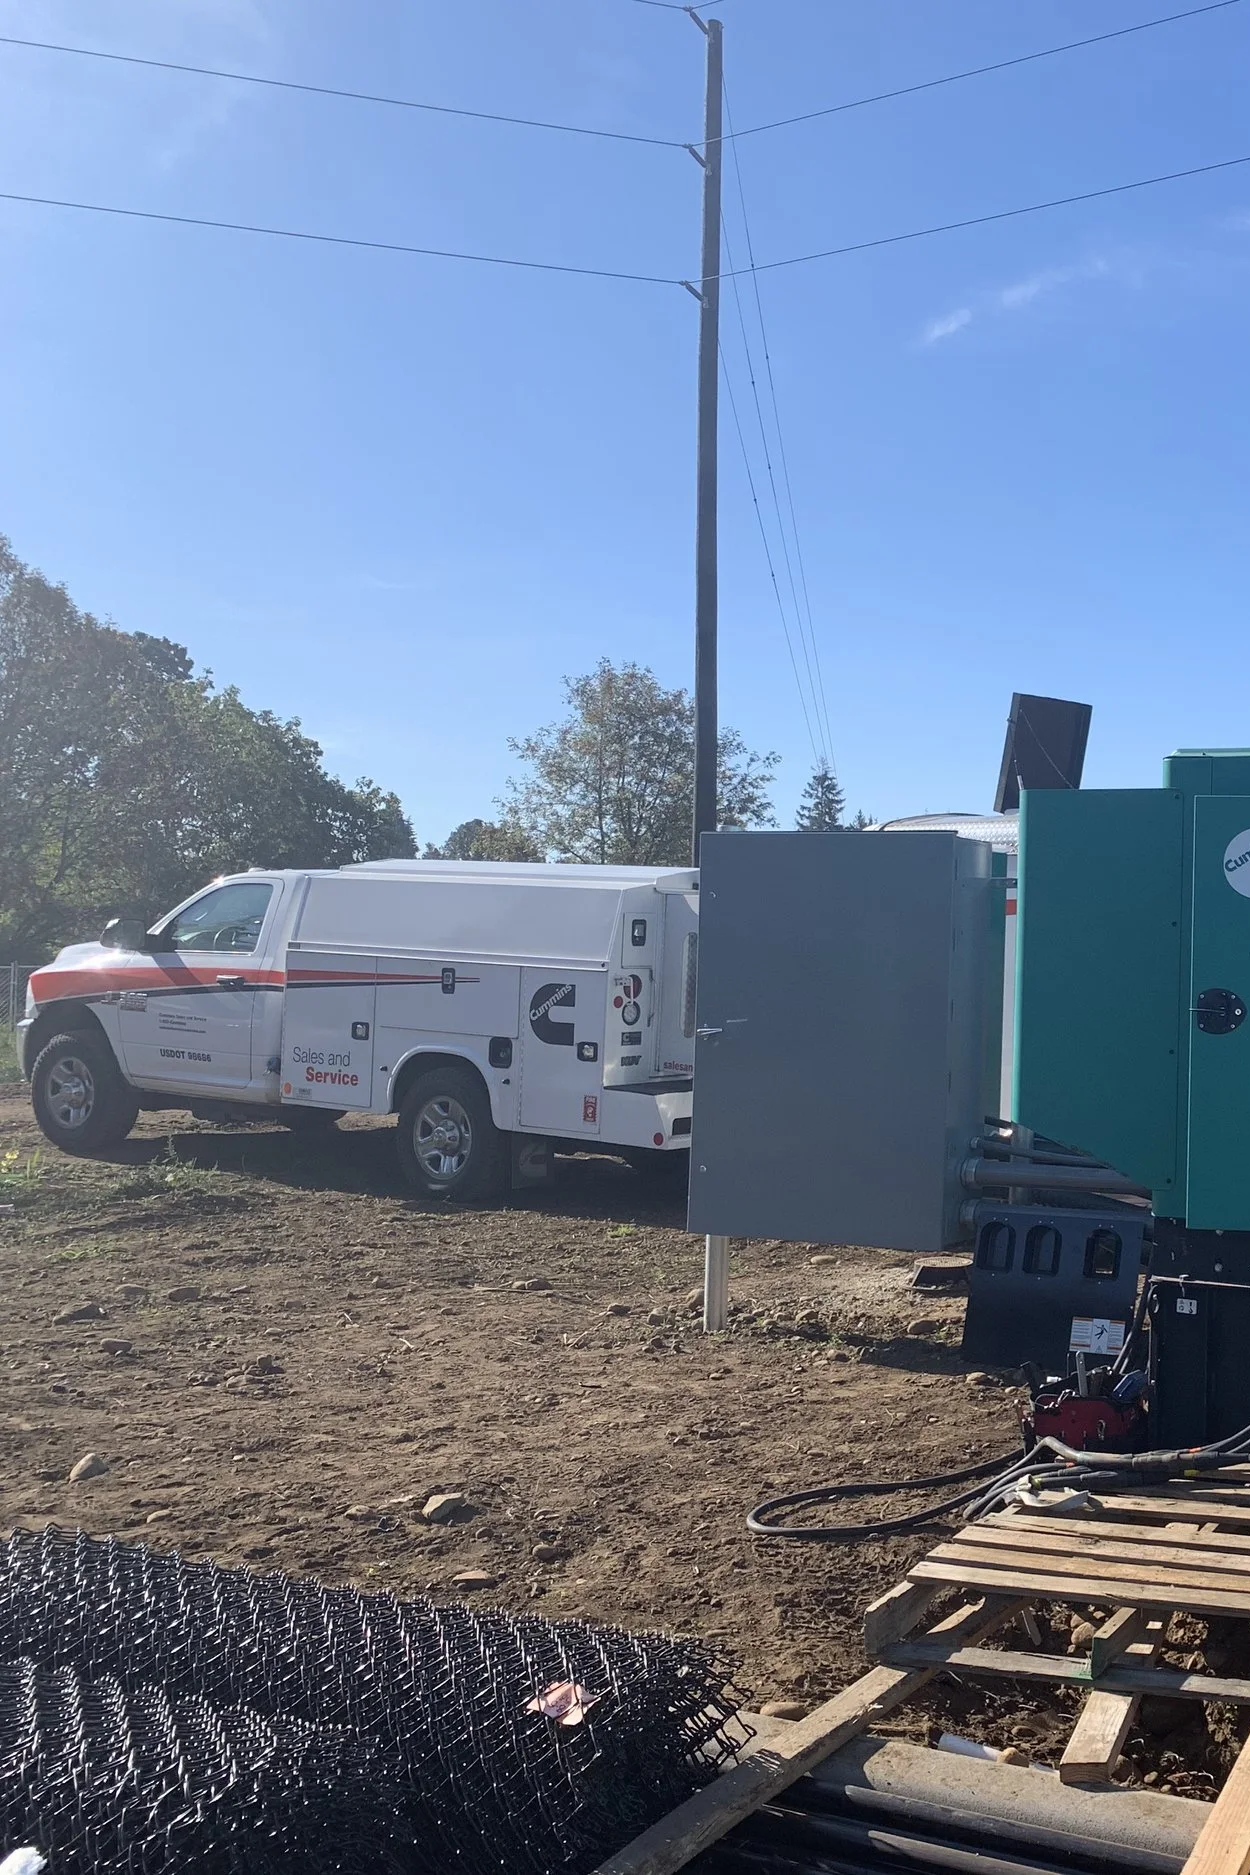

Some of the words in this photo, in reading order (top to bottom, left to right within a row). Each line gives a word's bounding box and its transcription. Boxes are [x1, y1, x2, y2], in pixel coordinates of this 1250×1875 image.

[530, 984, 573, 1021] Cummins
[159, 1048, 186, 1060] USDOT
[292, 1046, 325, 1064] Sales
[328, 1050, 351, 1067] and
[305, 1066, 359, 1087] Service
